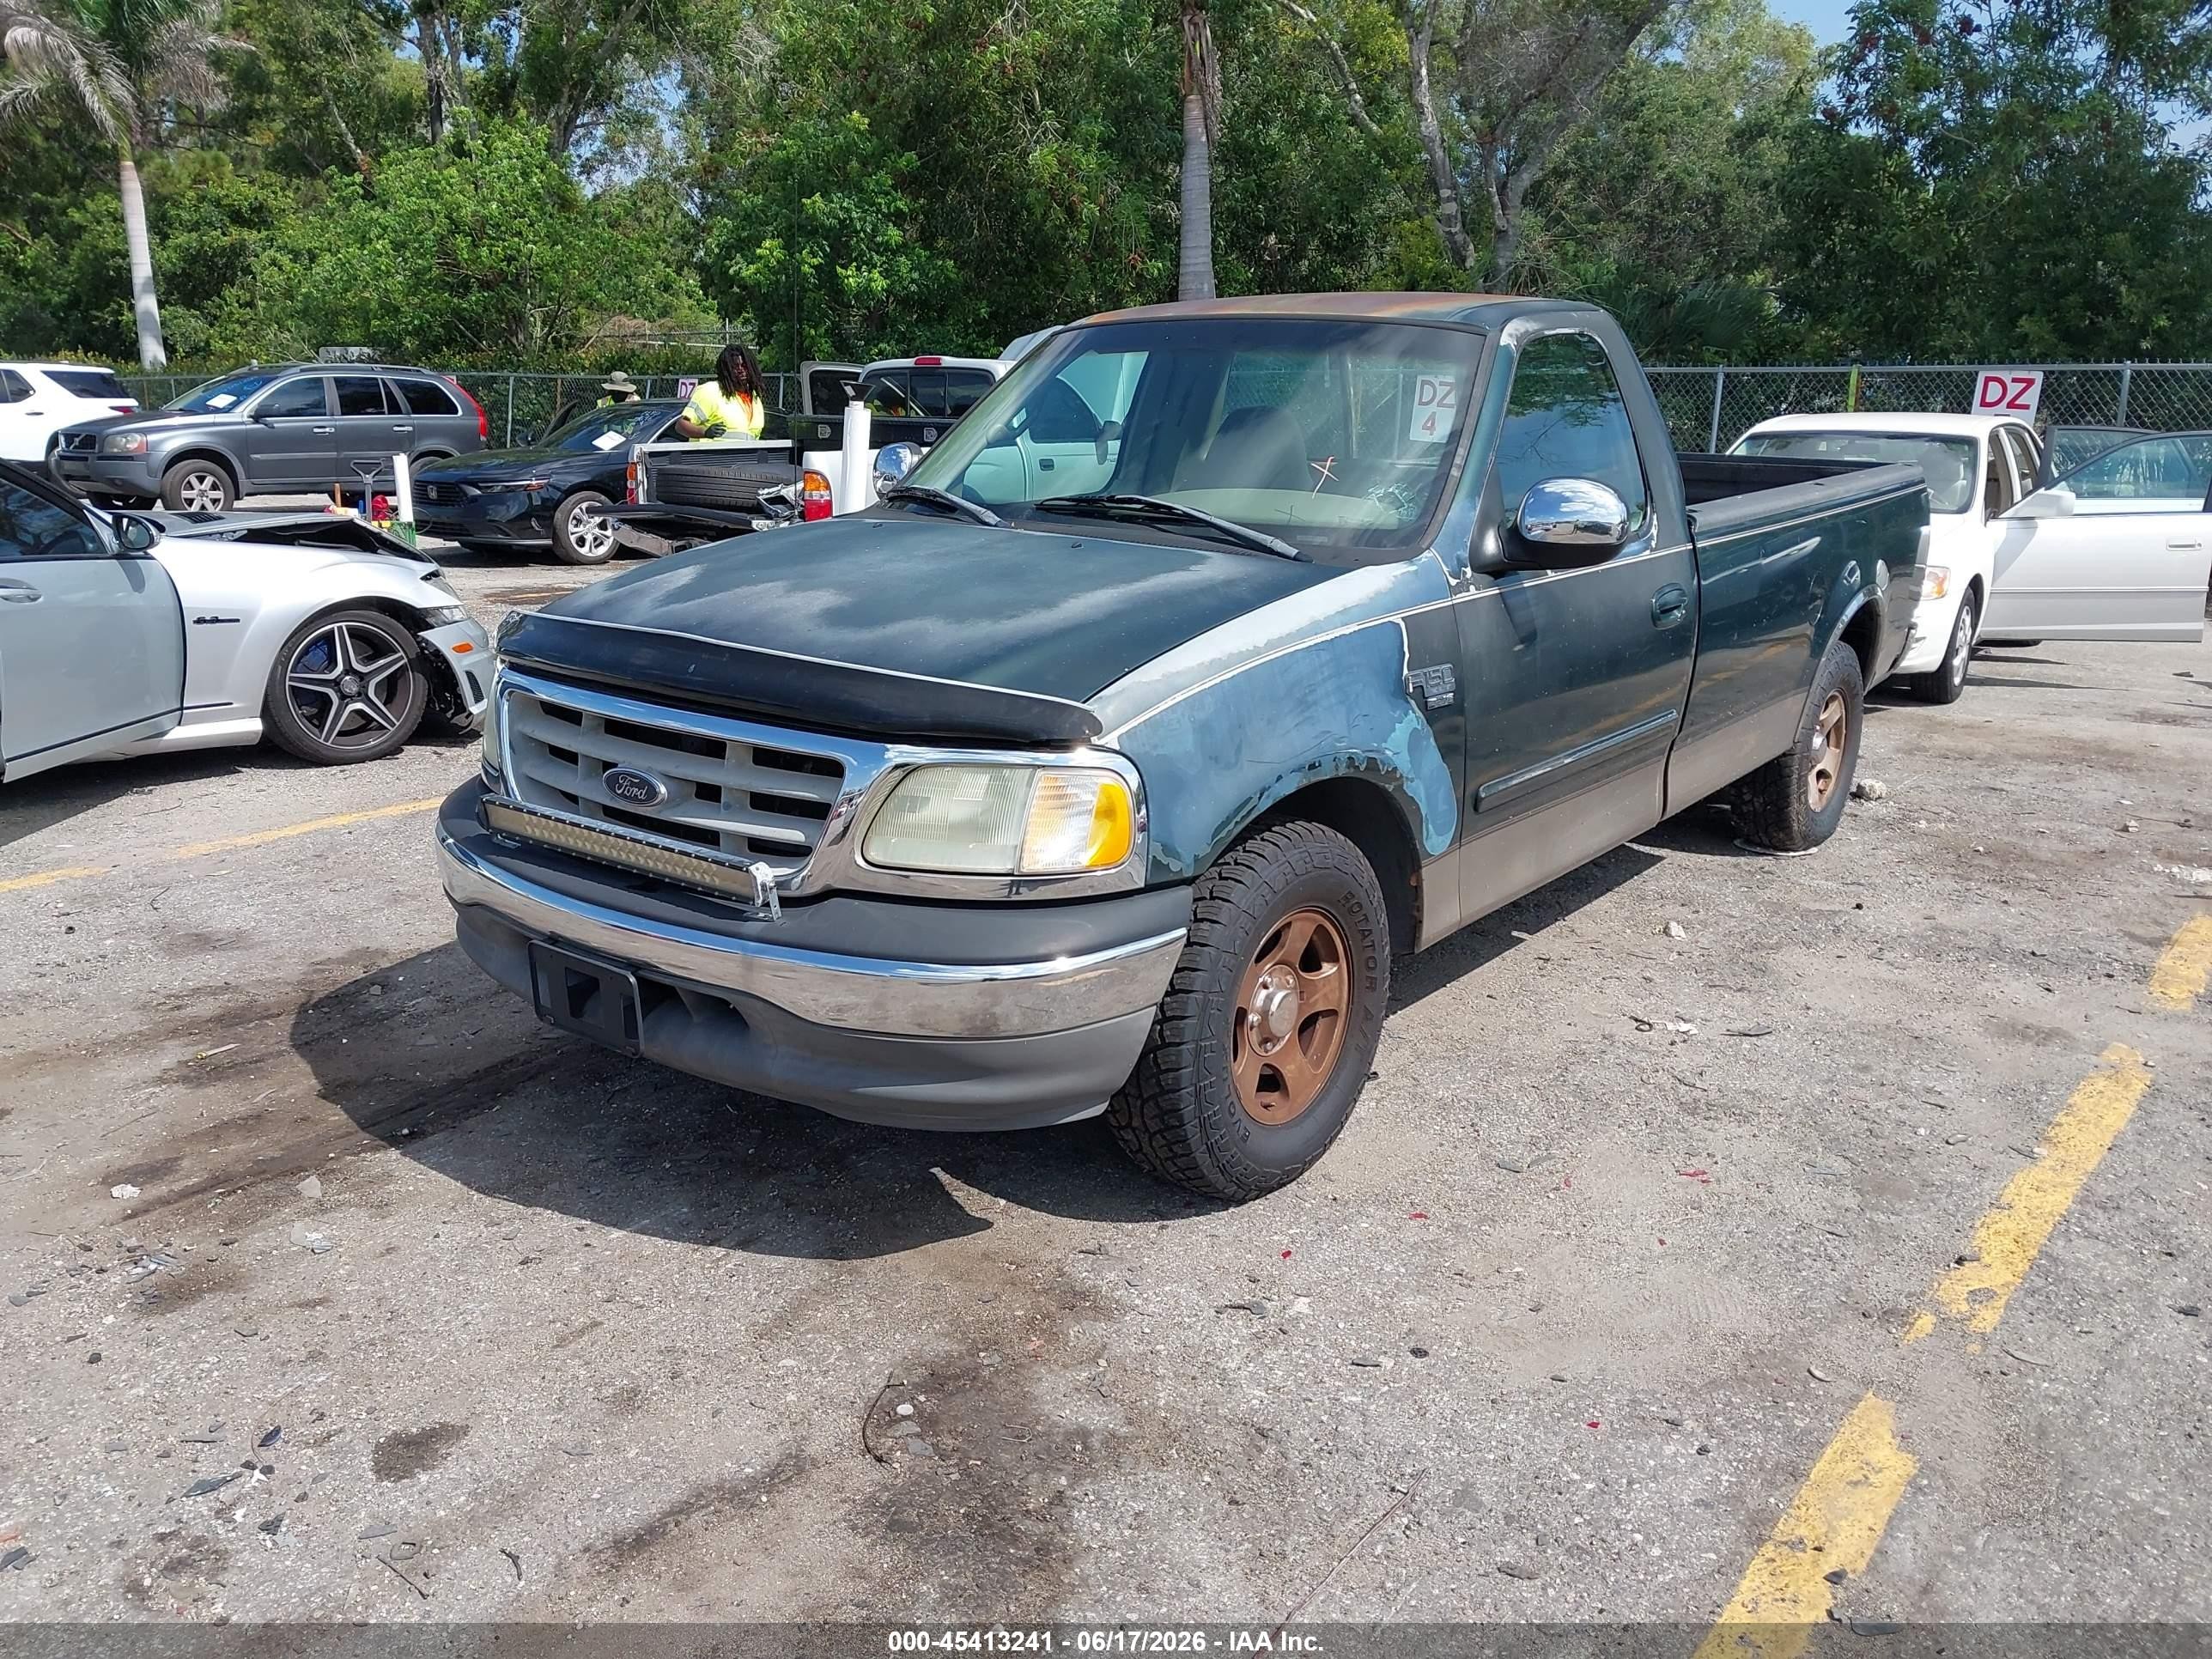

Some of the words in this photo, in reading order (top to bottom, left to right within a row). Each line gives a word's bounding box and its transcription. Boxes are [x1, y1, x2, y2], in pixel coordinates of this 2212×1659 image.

[1418, 379, 1455, 409] DZ
[1979, 375, 2037, 410] DZ
[1421, 410, 1437, 436] 4
[615, 774, 648, 800] Ford
[1338, 890, 1378, 993] ROTATOR
